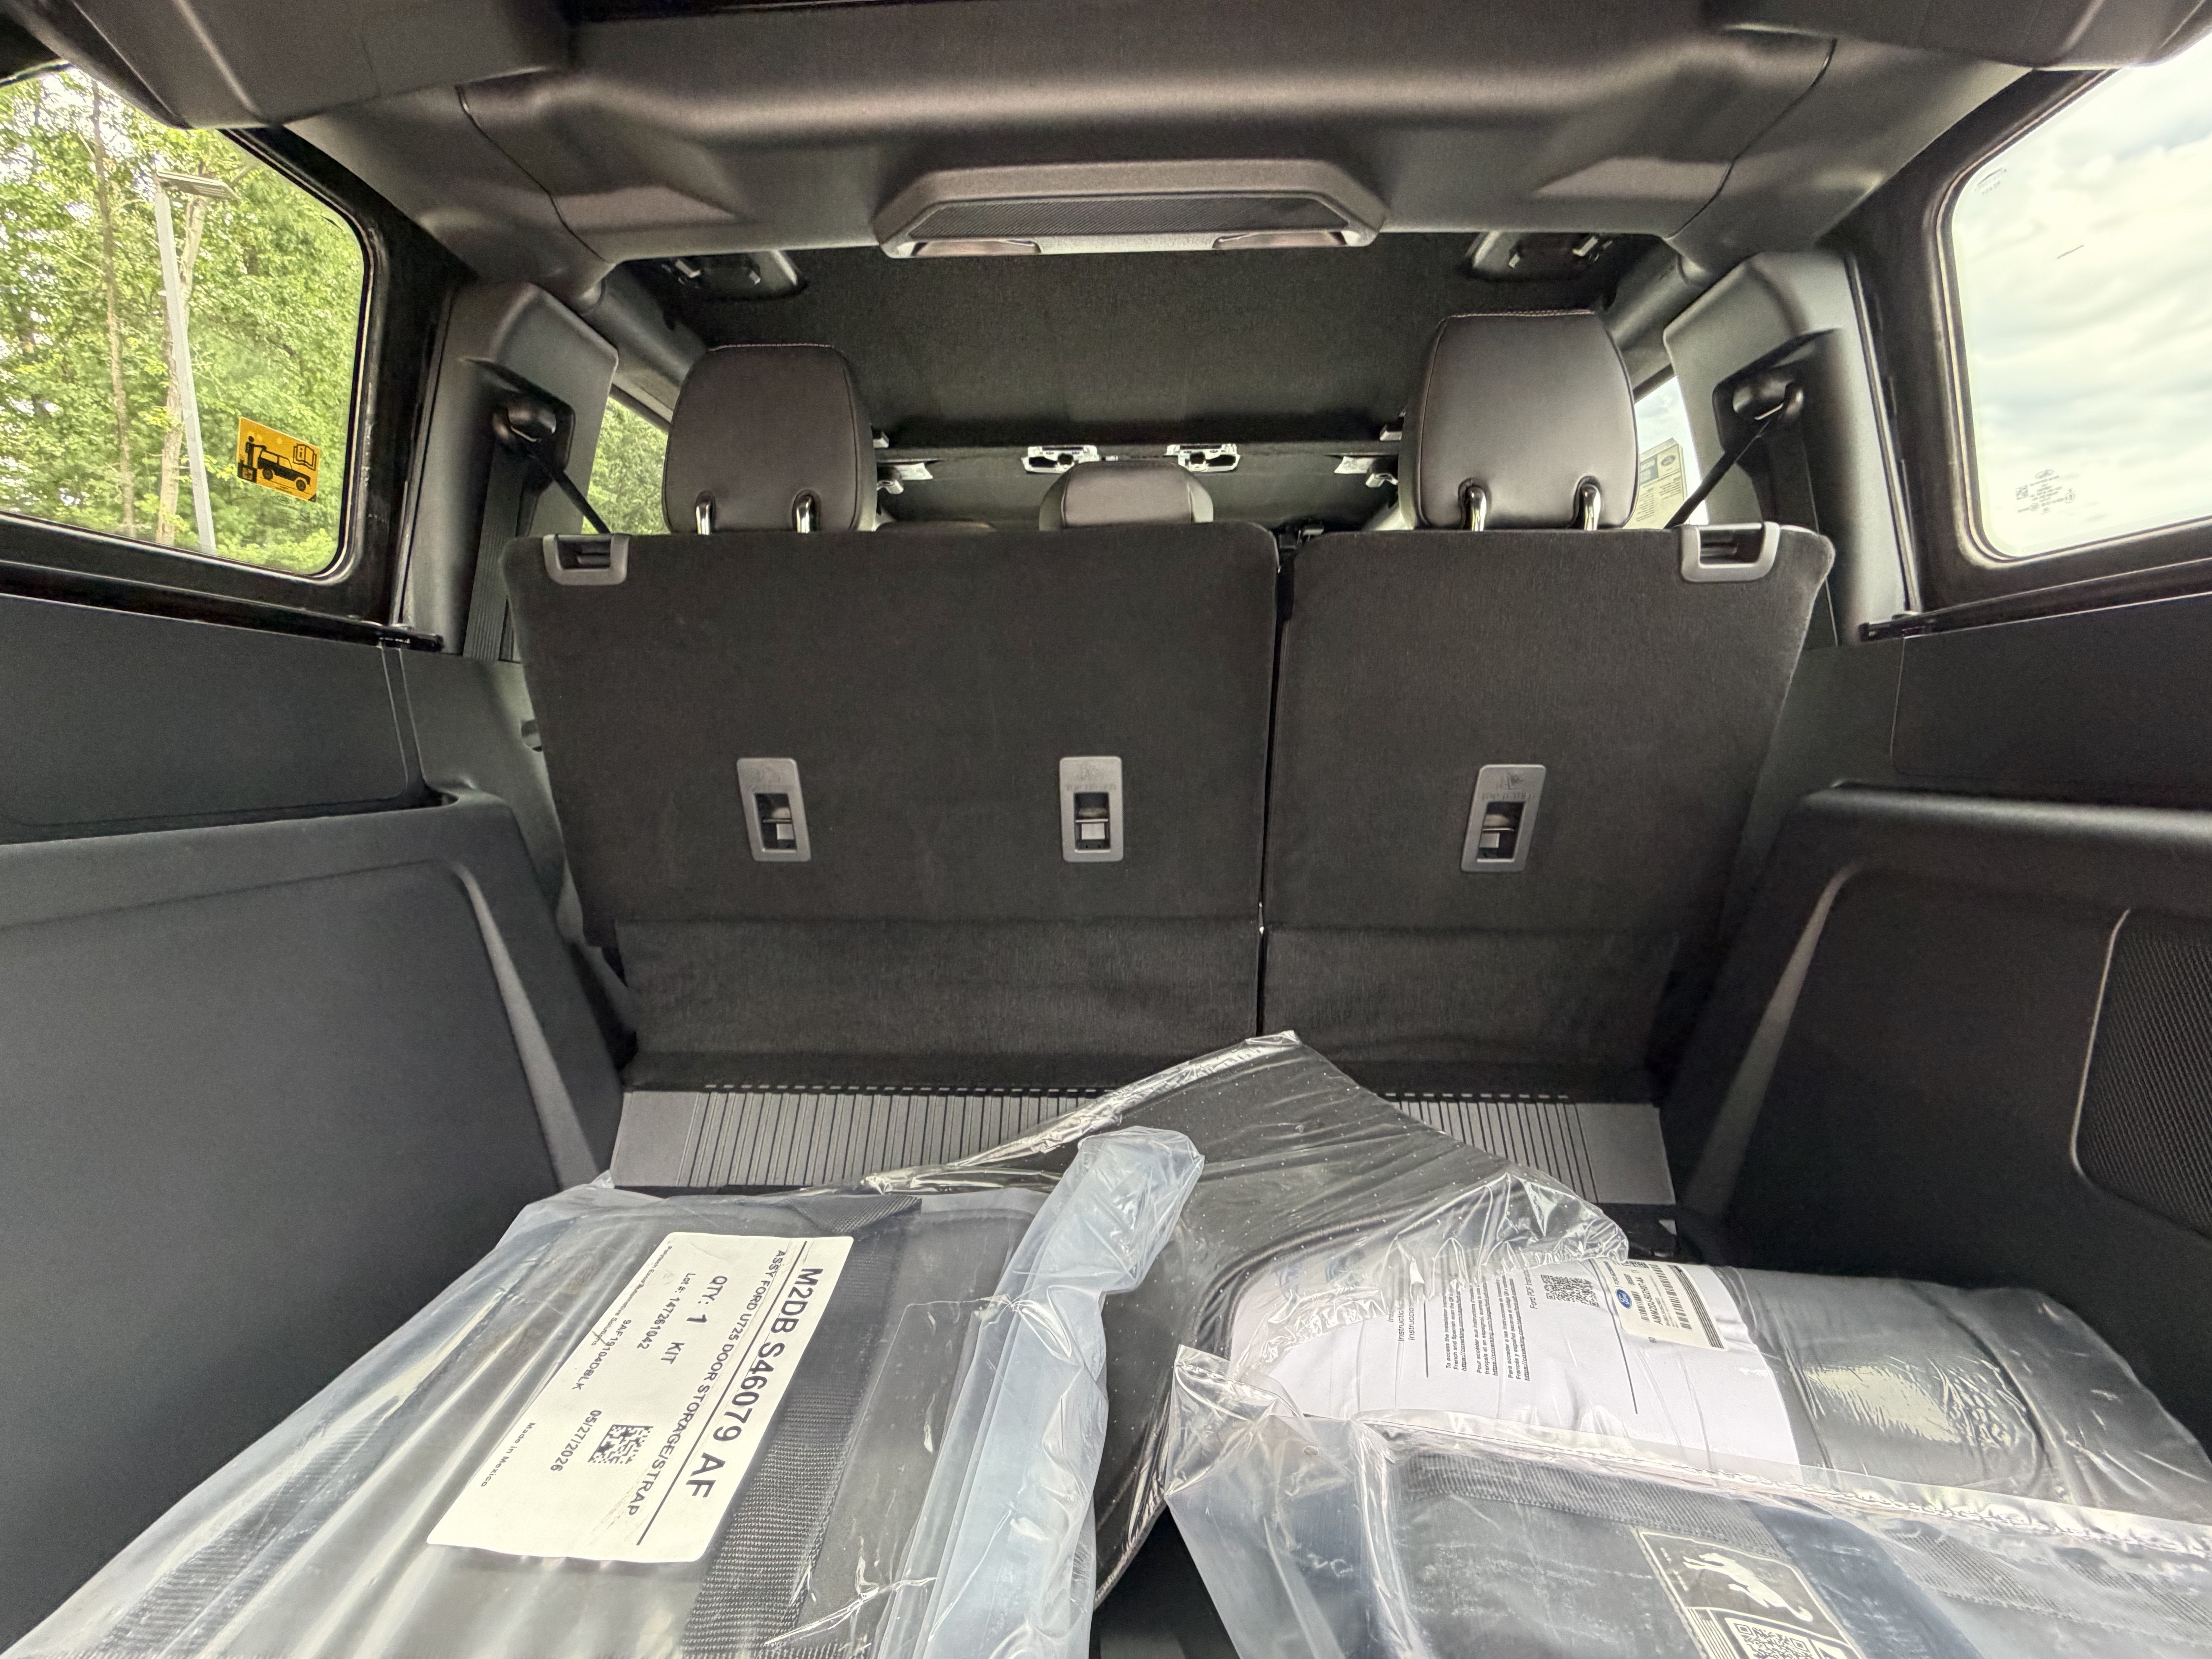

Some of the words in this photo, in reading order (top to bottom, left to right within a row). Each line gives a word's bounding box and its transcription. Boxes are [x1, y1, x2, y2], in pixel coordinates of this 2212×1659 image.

[765, 1249, 787, 1277] ASSY
[680, 1273, 696, 1285] Lot
[698, 1276, 728, 1304] QTY:
[746, 1280, 770, 1310] FORD
[770, 1268, 823, 1333] M2DB
[1528, 1297, 1538, 1309] Ford
[591, 1317, 617, 1346] Solutions
[637, 1297, 680, 1349] 147261042
[686, 1314, 707, 1323] 1
[728, 1313, 752, 1340] U725
[573, 1319, 631, 1389] 9AF19104DBLK
[661, 1342, 685, 1364] KIT
[1510, 1332, 1518, 1352] español
[703, 1344, 734, 1381] DOOR
[1513, 1357, 1522, 1379] Francés
[713, 1341, 785, 1441] S46079
[514, 1422, 536, 1443] Made
[550, 1410, 601, 1471] 05/27/2026
[505, 1446, 518, 1454] in
[628, 1385, 709, 1515] STORAGE/STRAP
[481, 1456, 509, 1487] Mexico
[686, 1453, 725, 1498] AF
